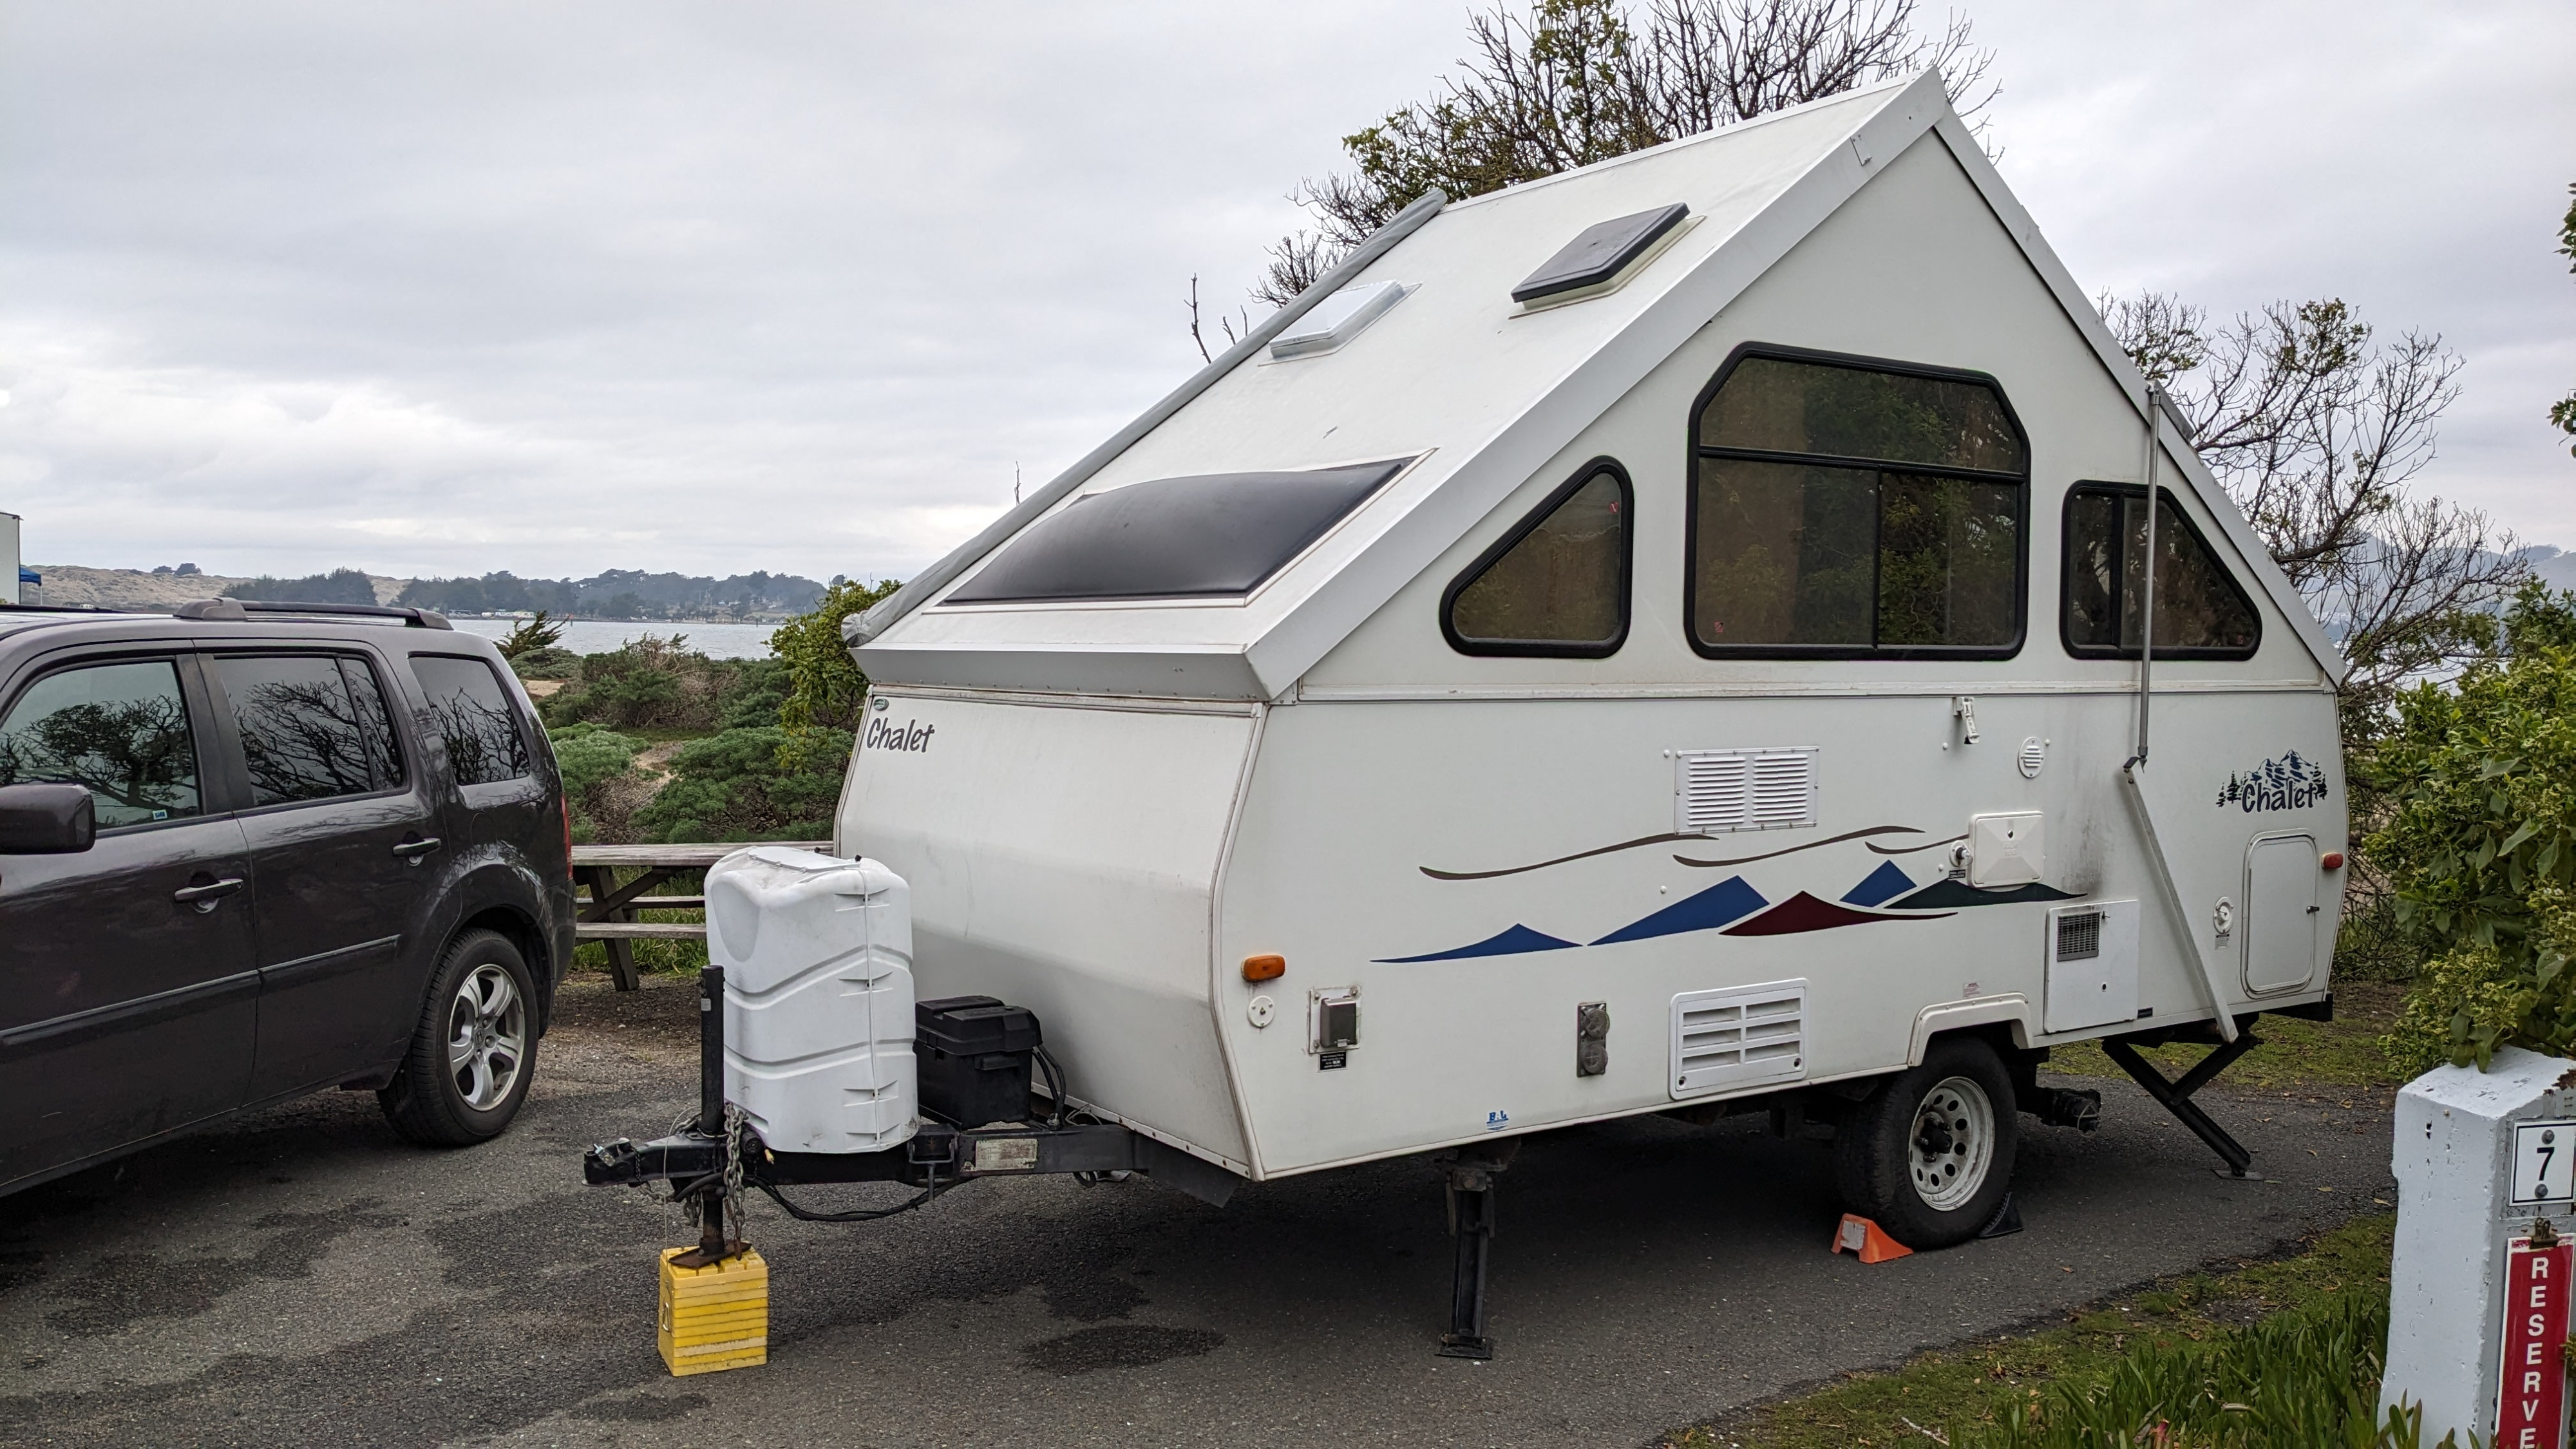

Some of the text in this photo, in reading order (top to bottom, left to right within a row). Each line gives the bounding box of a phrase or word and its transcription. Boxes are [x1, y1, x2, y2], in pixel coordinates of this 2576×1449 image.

[866, 717, 935, 753] Chalet
[2242, 780, 2316, 813] Chalet
[2536, 1146, 2555, 1181] 7
